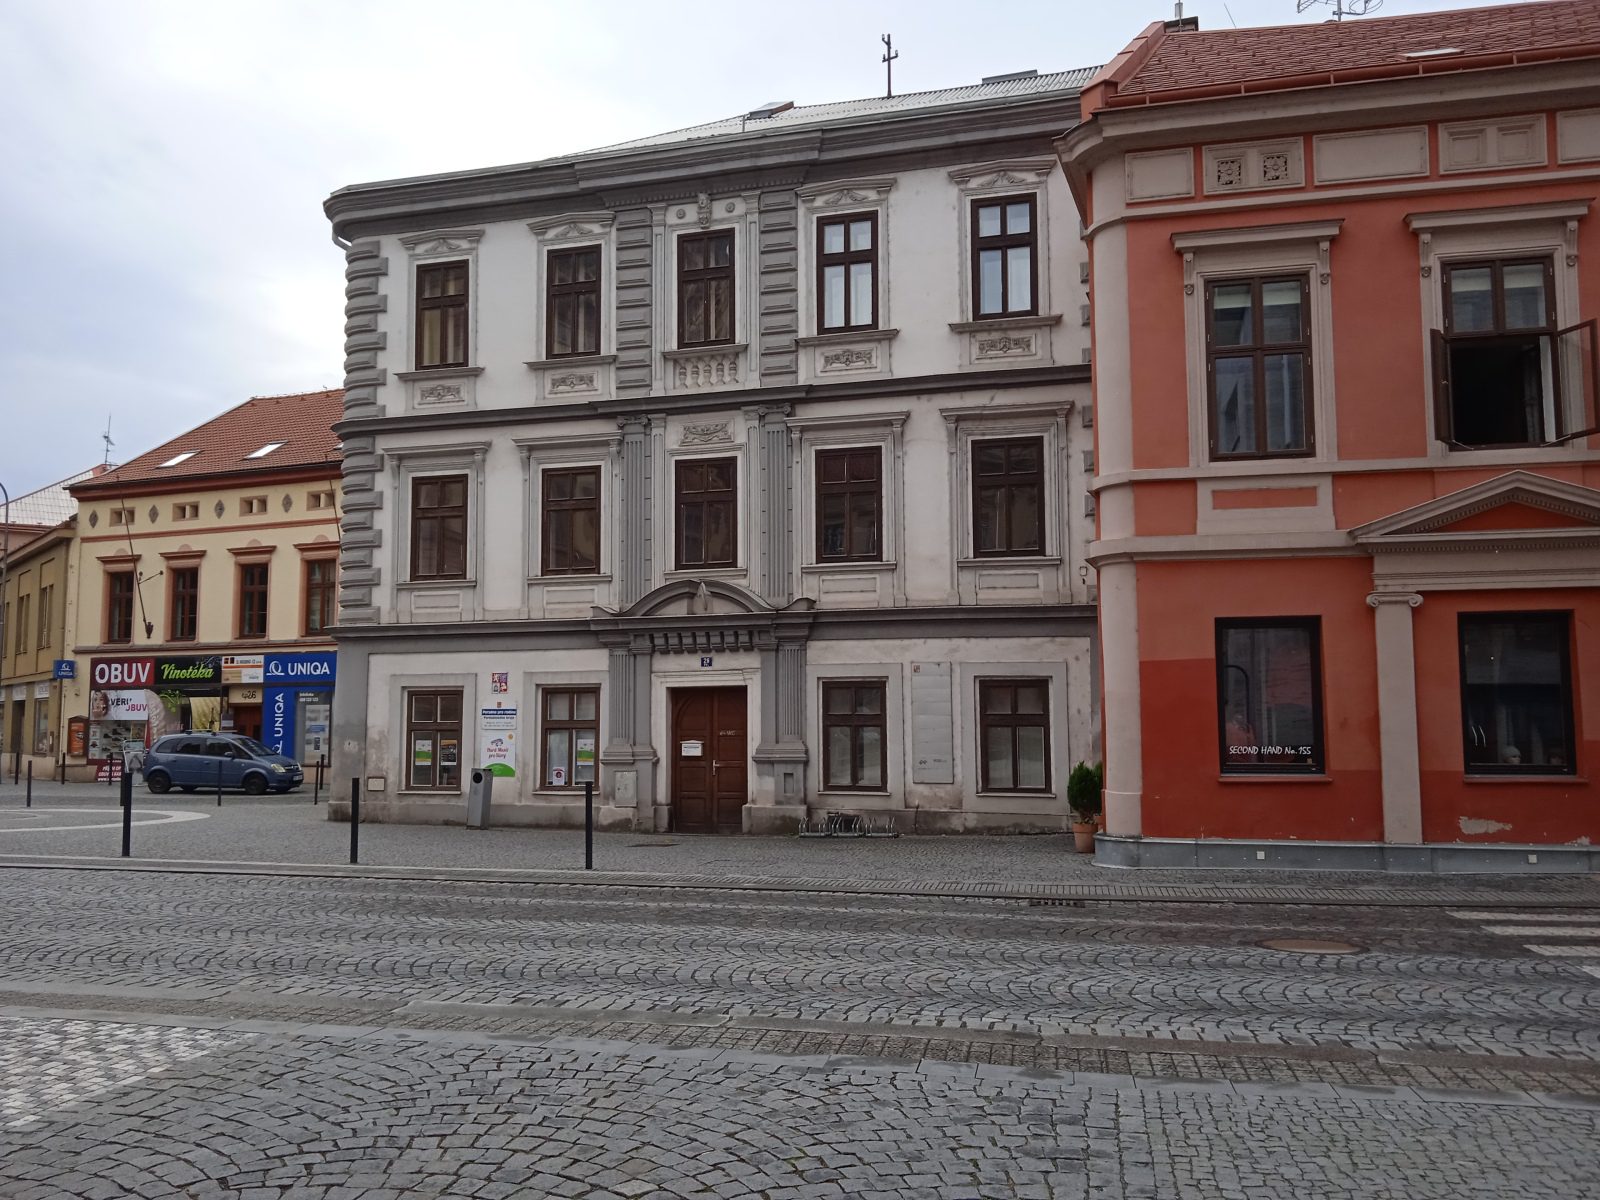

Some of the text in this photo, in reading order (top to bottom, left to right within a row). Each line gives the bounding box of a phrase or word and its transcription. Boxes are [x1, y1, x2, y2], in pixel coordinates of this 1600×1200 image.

[95, 662, 151, 684] OBUV
[160, 662, 215, 680] Vinotéka
[288, 661, 331, 676] UNIQA
[274, 692, 284, 737] UNIQA
[1229, 745, 1312, 755] SECOND HAND No. 155
